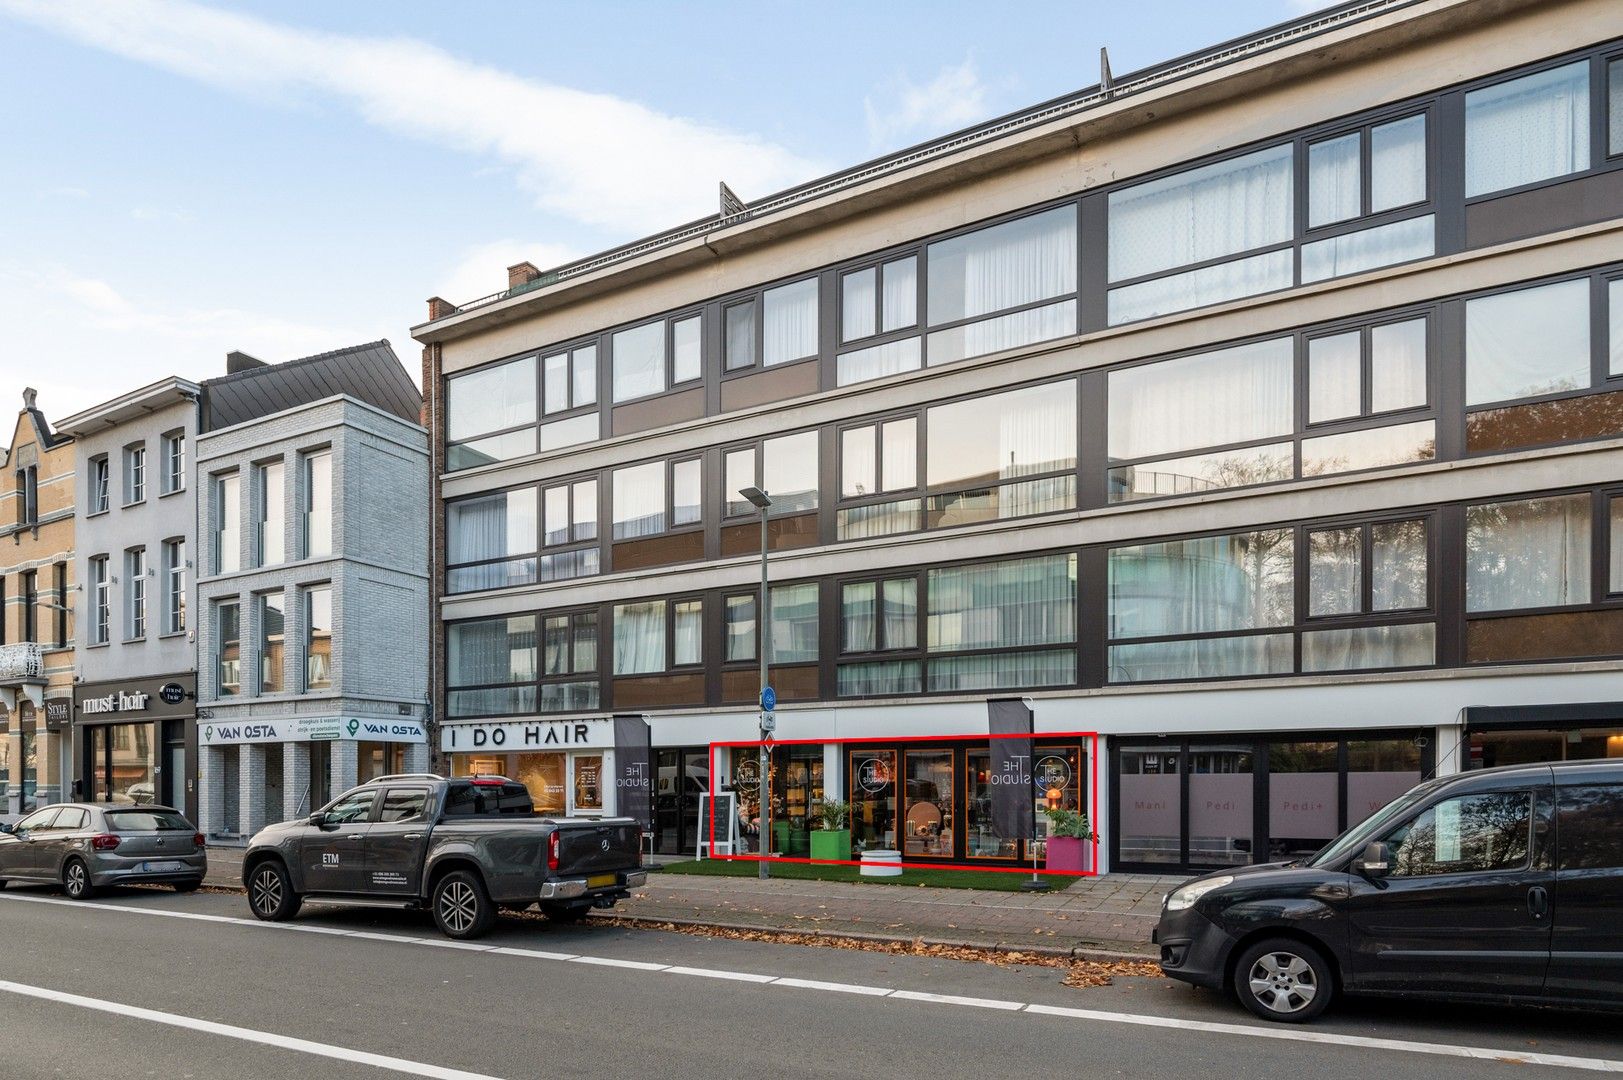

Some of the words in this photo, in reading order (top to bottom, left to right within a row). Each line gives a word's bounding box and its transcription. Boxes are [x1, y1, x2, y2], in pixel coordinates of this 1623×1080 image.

[83, 690, 148, 714] must-hair
[217, 726, 241, 739] VAN
[244, 725, 277, 739] OSTA
[364, 724, 388, 734] VAN
[392, 725, 422, 735] OSTA
[451, 730, 456, 747] I
[474, 728, 506, 746] DO
[525, 724, 588, 745] HAIR
[1135, 801, 1166, 810] Mani
[1206, 801, 1236, 810] Pedi
[322, 853, 339, 863] ETM
